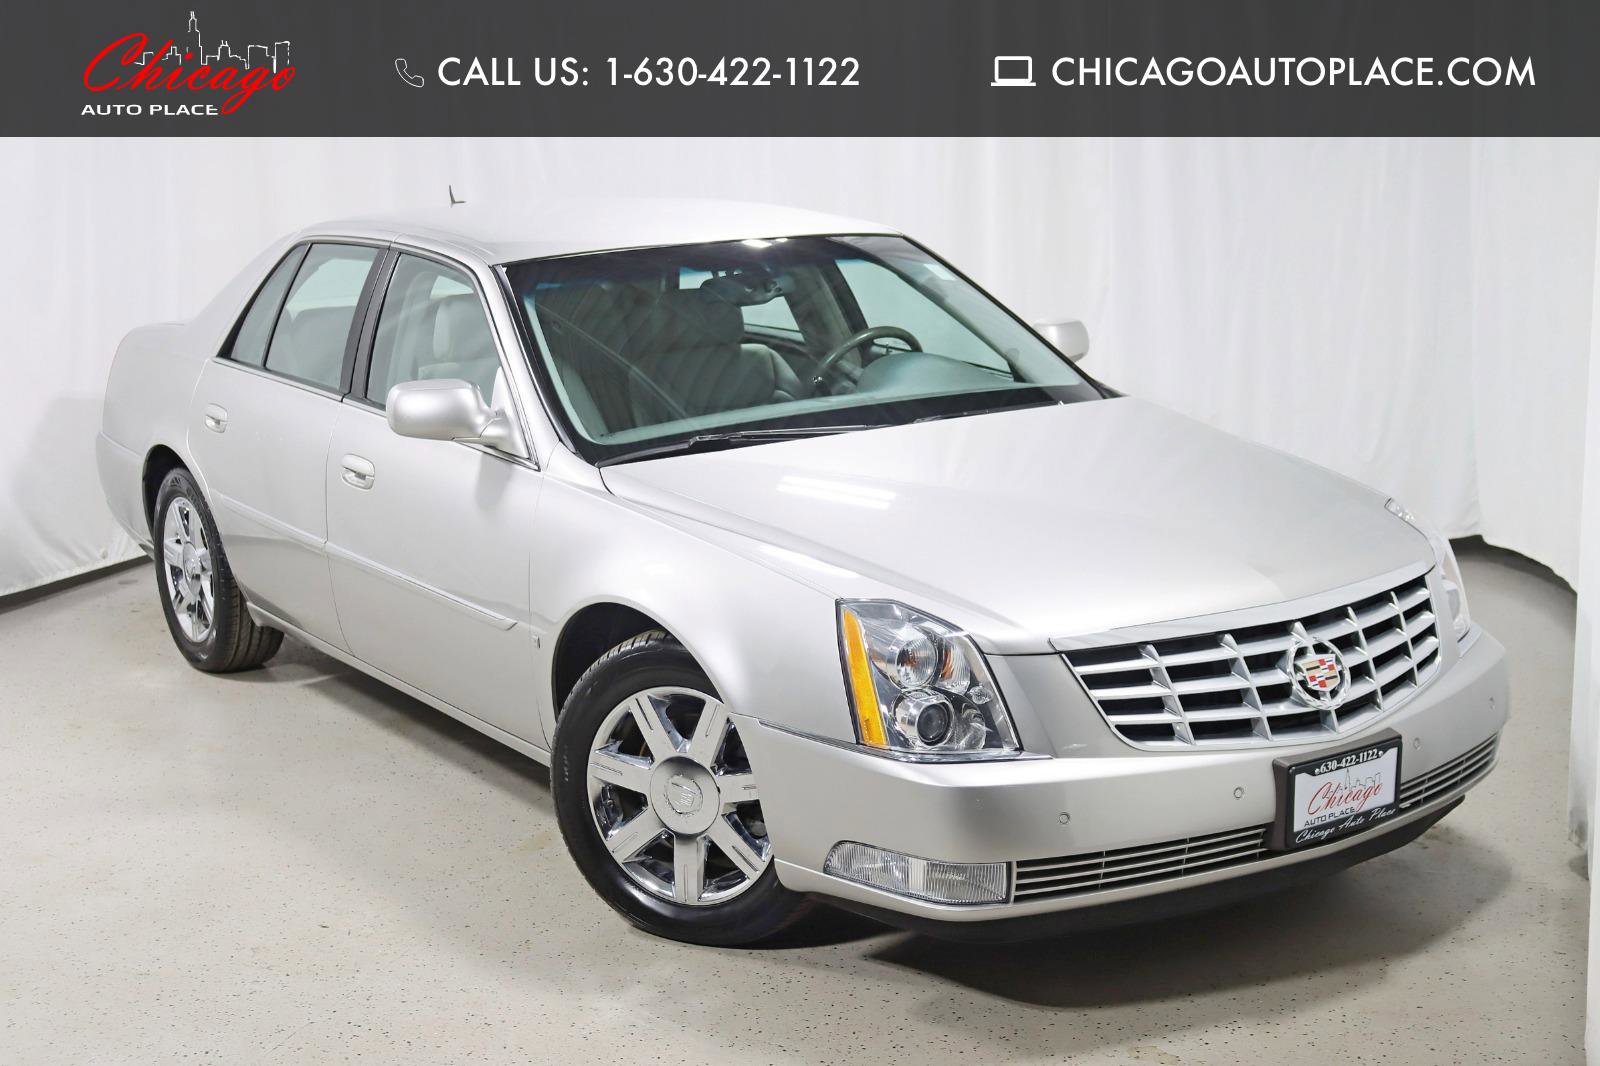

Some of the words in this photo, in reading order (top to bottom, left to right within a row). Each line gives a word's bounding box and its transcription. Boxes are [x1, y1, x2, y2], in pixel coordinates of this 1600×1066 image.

[1307, 781, 1383, 816] Chicago
[1295, 827, 1336, 844] Chicago
[1338, 815, 1365, 831] Auto
[1368, 807, 1396, 821] Place
[1303, 813, 1327, 828] AUTO
[1327, 806, 1356, 821] PLACE
